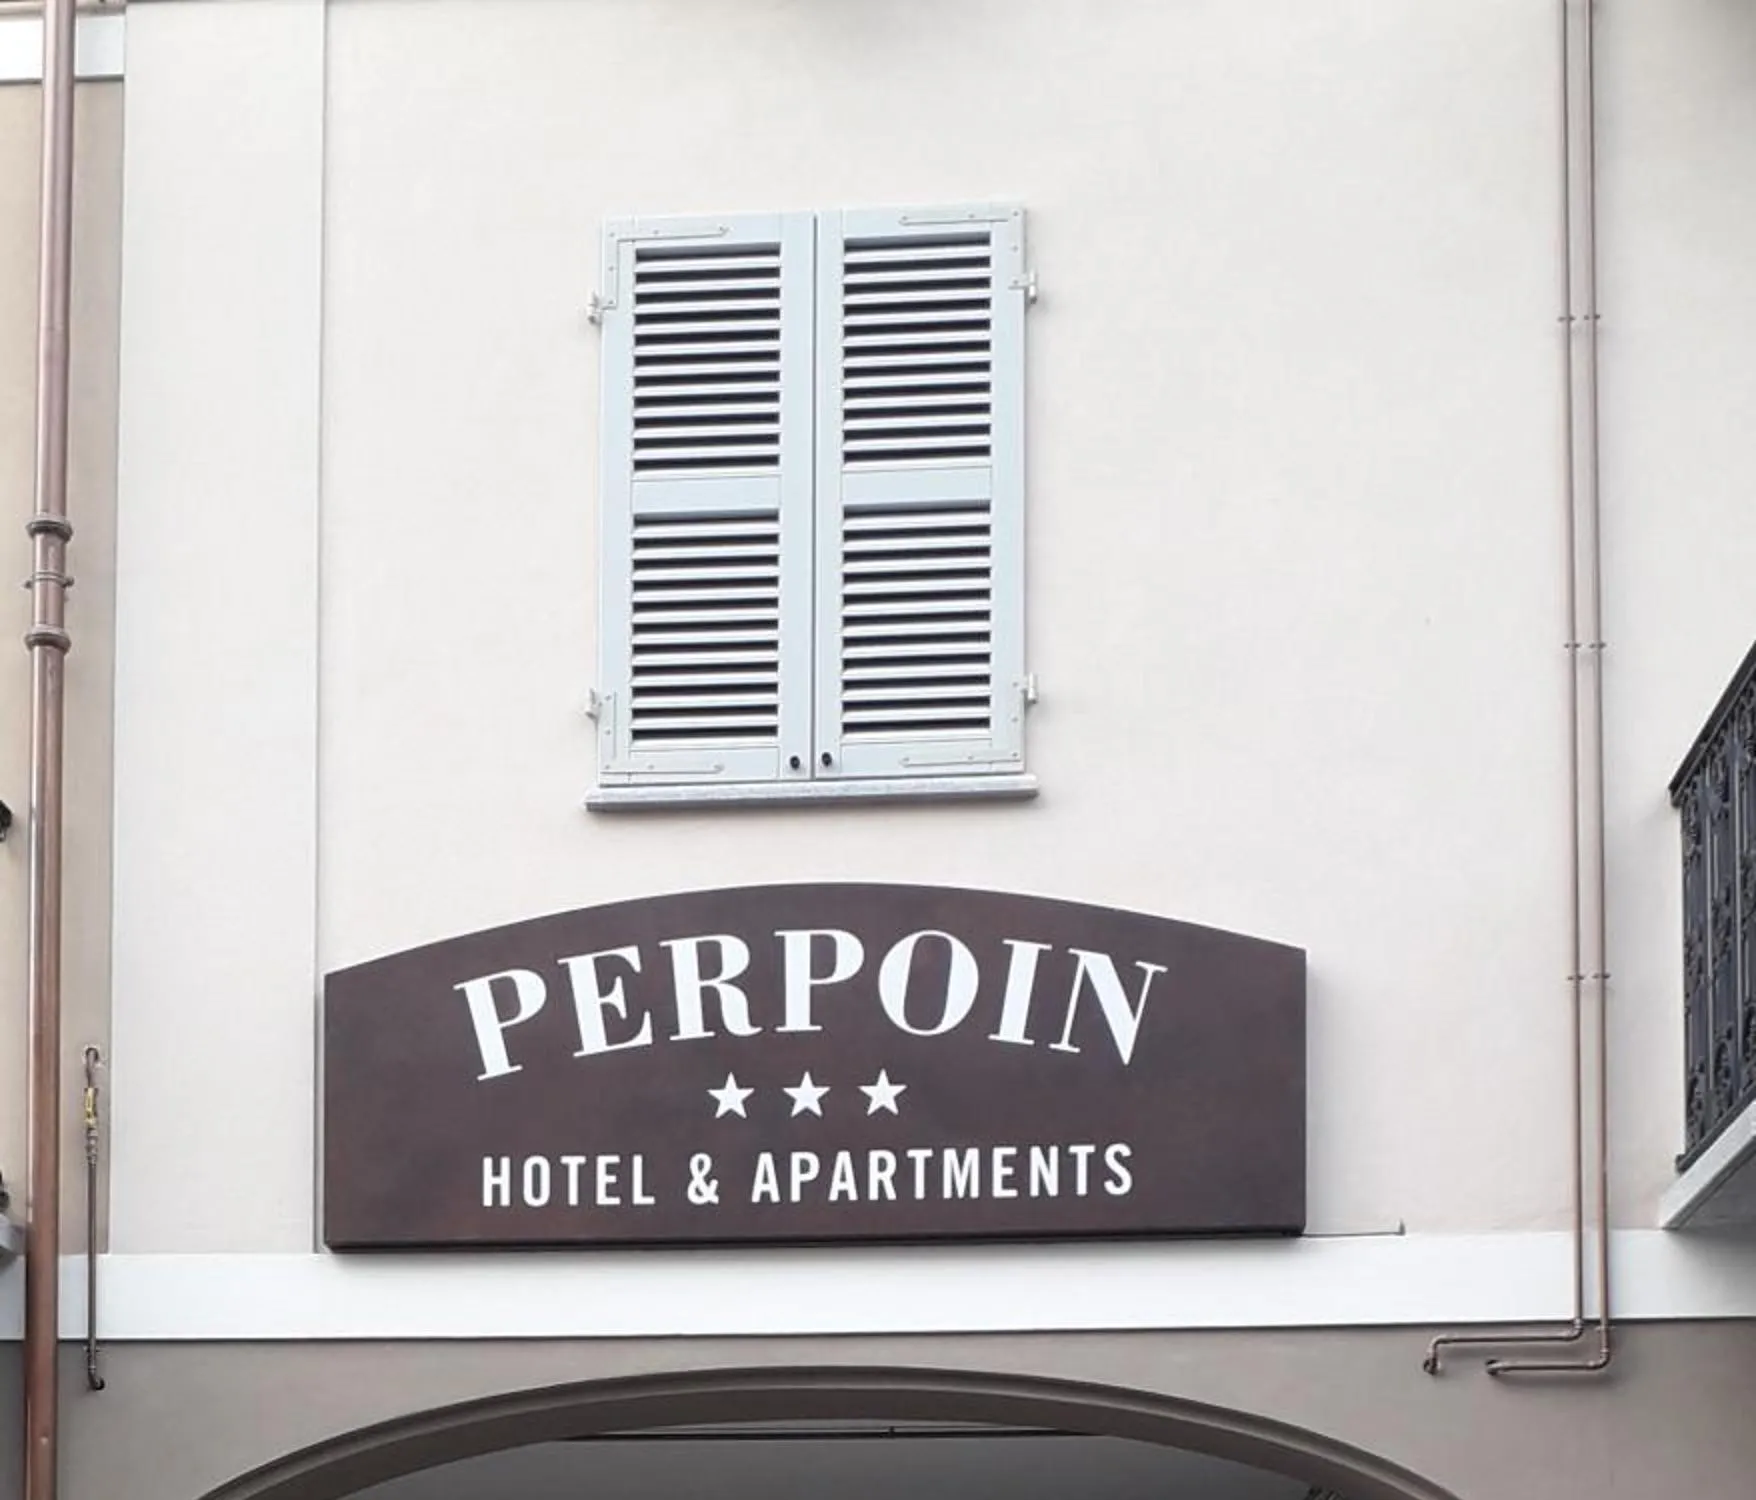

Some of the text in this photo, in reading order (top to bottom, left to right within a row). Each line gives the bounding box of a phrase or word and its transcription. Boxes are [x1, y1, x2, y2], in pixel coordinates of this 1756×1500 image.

[453, 928, 1168, 1081] PERPOIN
[482, 1143, 1133, 1207] HOTEL & APARTMENTS
